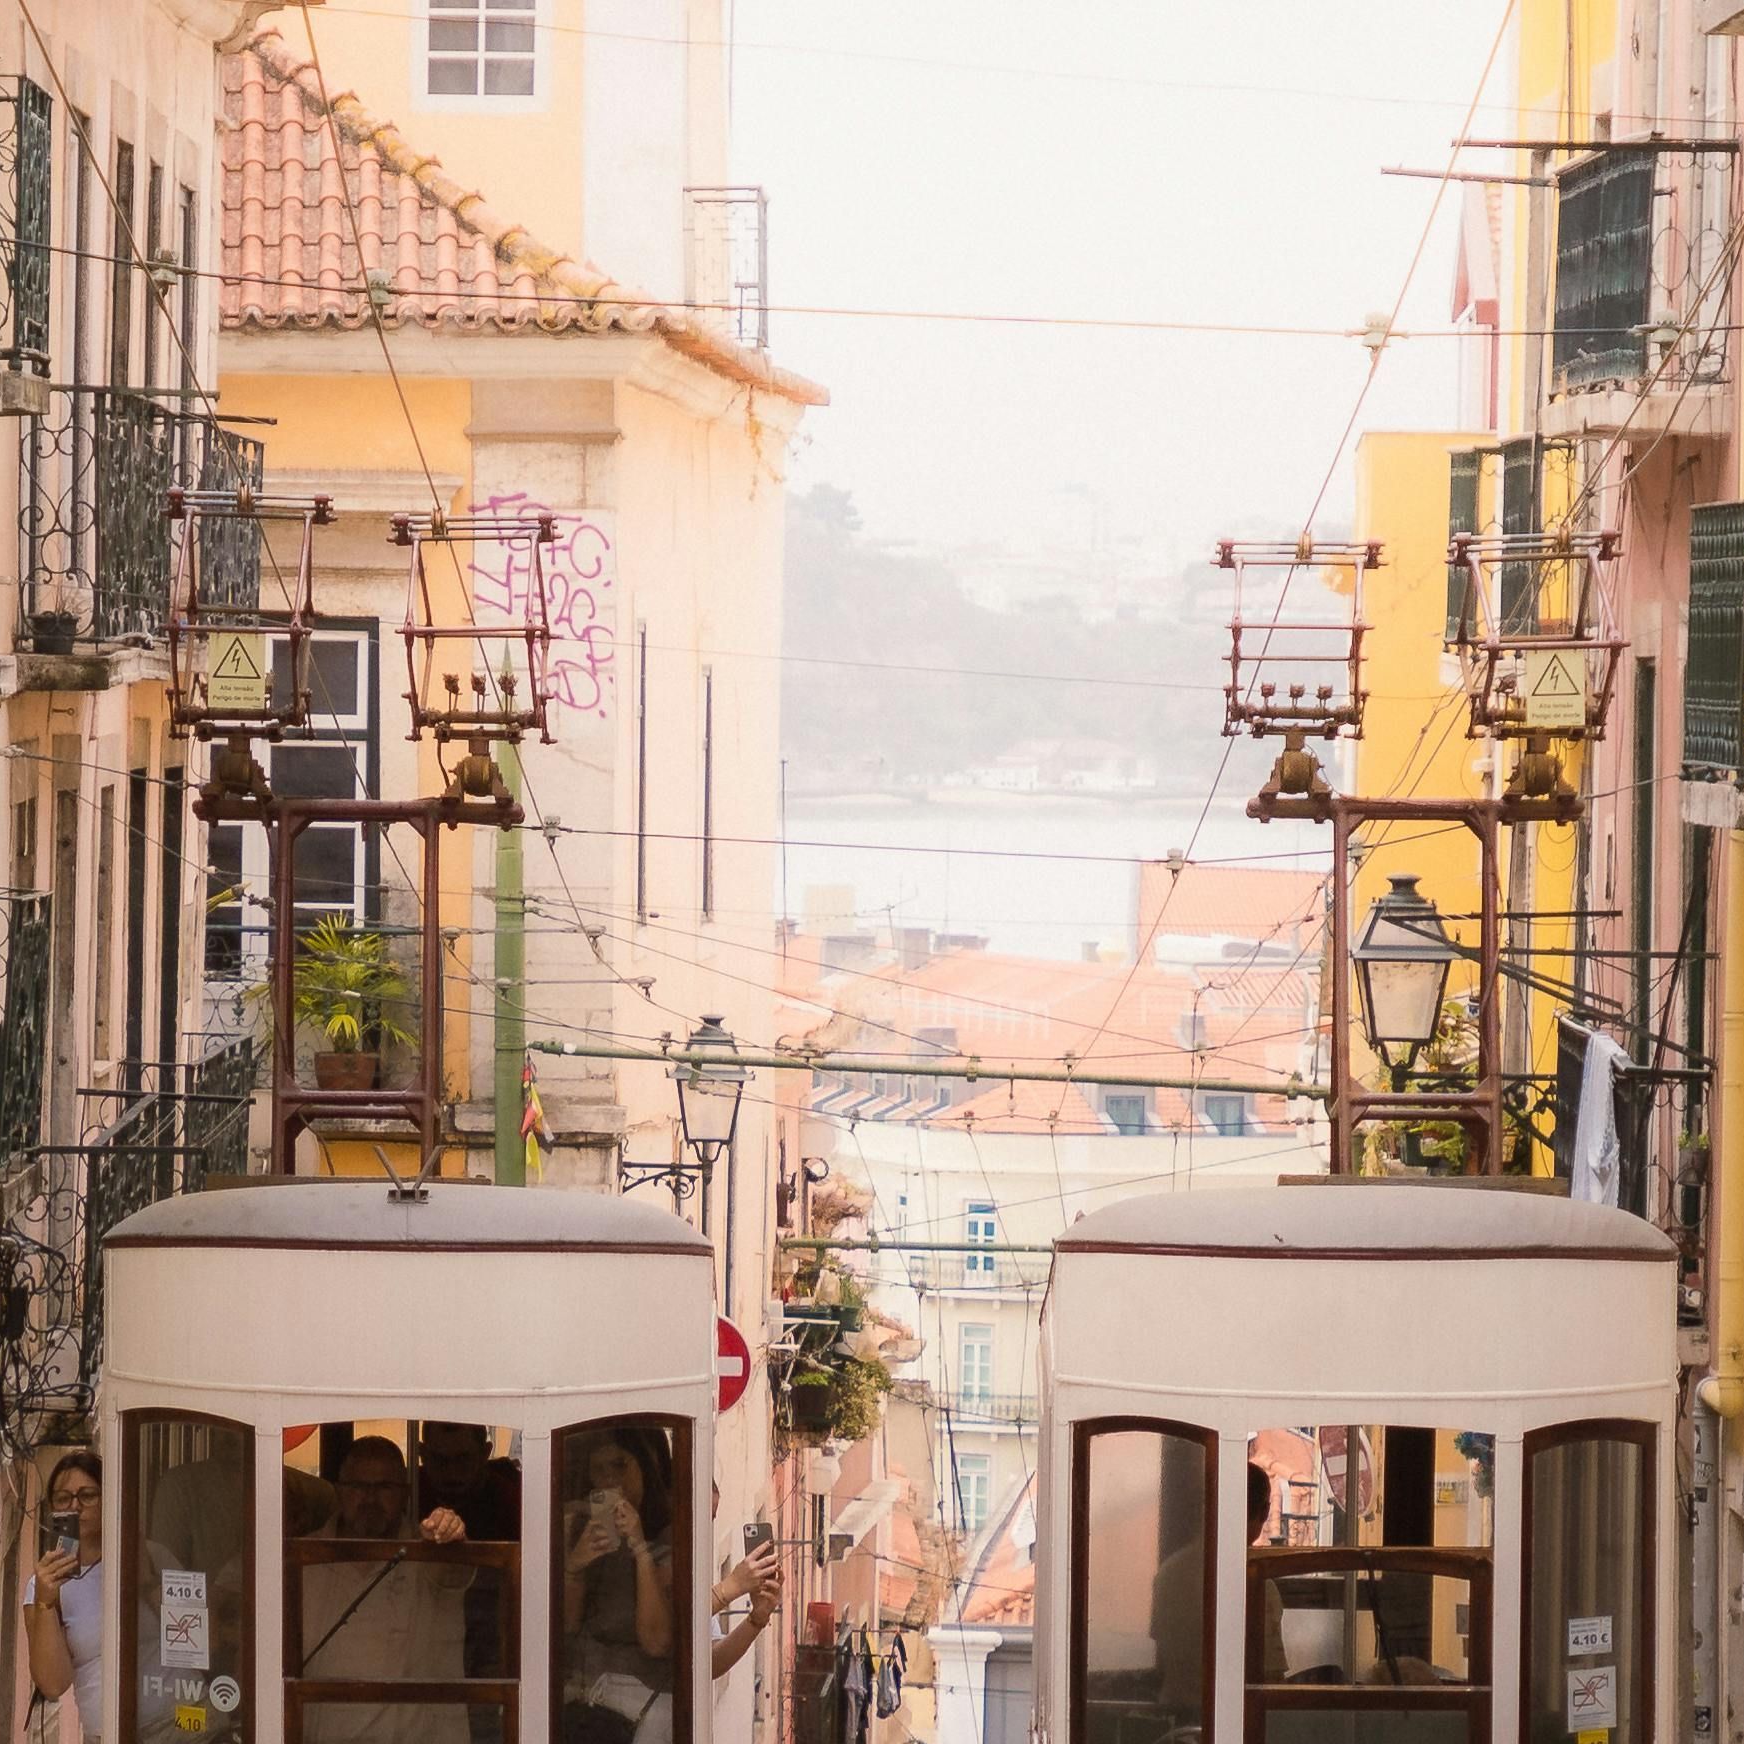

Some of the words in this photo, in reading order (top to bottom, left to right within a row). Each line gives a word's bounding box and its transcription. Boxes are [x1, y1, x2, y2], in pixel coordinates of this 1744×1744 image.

[165, 1586, 192, 1600] 4.10
[194, 1588, 203, 1600] €
[1572, 1633, 1598, 1646] 4.10
[1601, 1632, 1609, 1644] €
